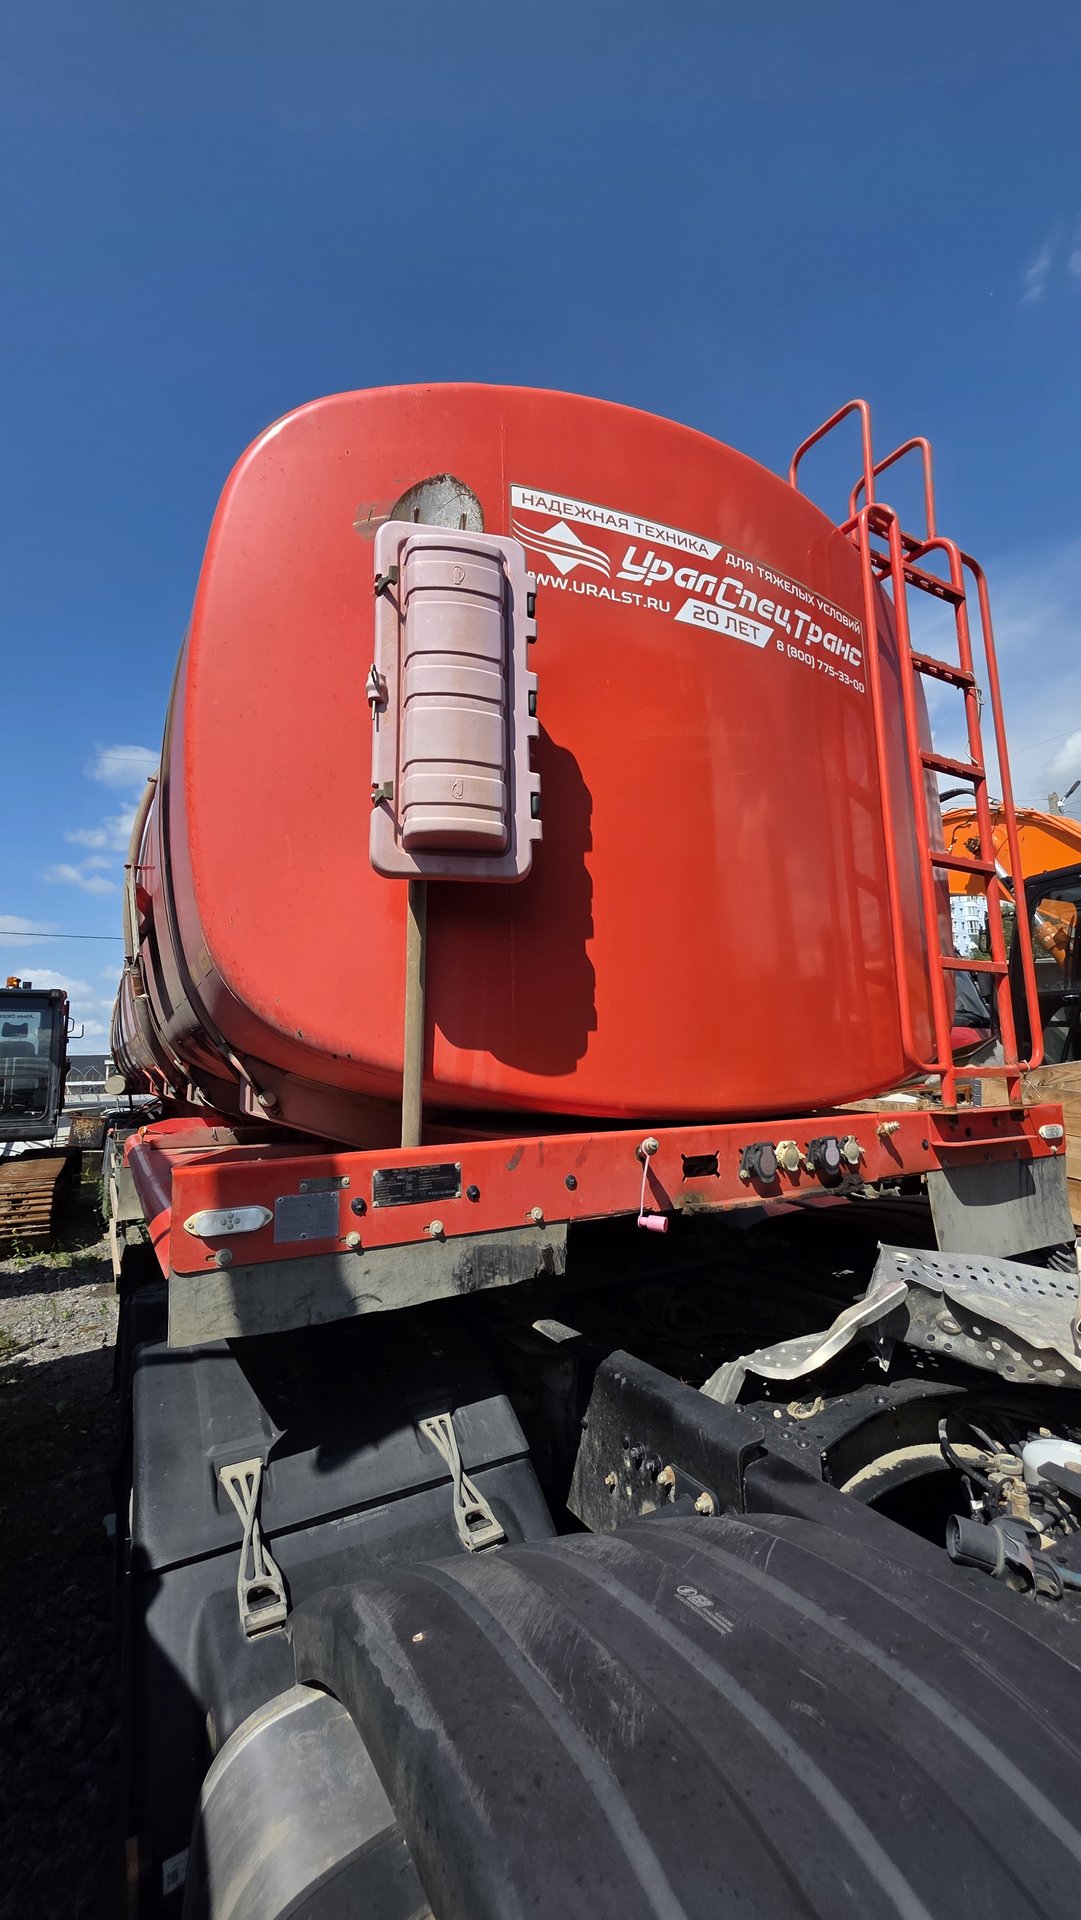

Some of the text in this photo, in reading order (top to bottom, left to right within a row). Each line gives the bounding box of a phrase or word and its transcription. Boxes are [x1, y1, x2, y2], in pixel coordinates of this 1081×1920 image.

[521, 492, 861, 635] НАДЕЖНАЯ ТЕХНИКА ДЛЯ ТЯЖЕЛЫХ УСЛОВИЙ
[527, 570, 671, 613] WW.URALST.RU
[693, 604, 761, 640] 20 ЛЕТ
[776, 639, 865, 693] 8 (800) 775-33-00
